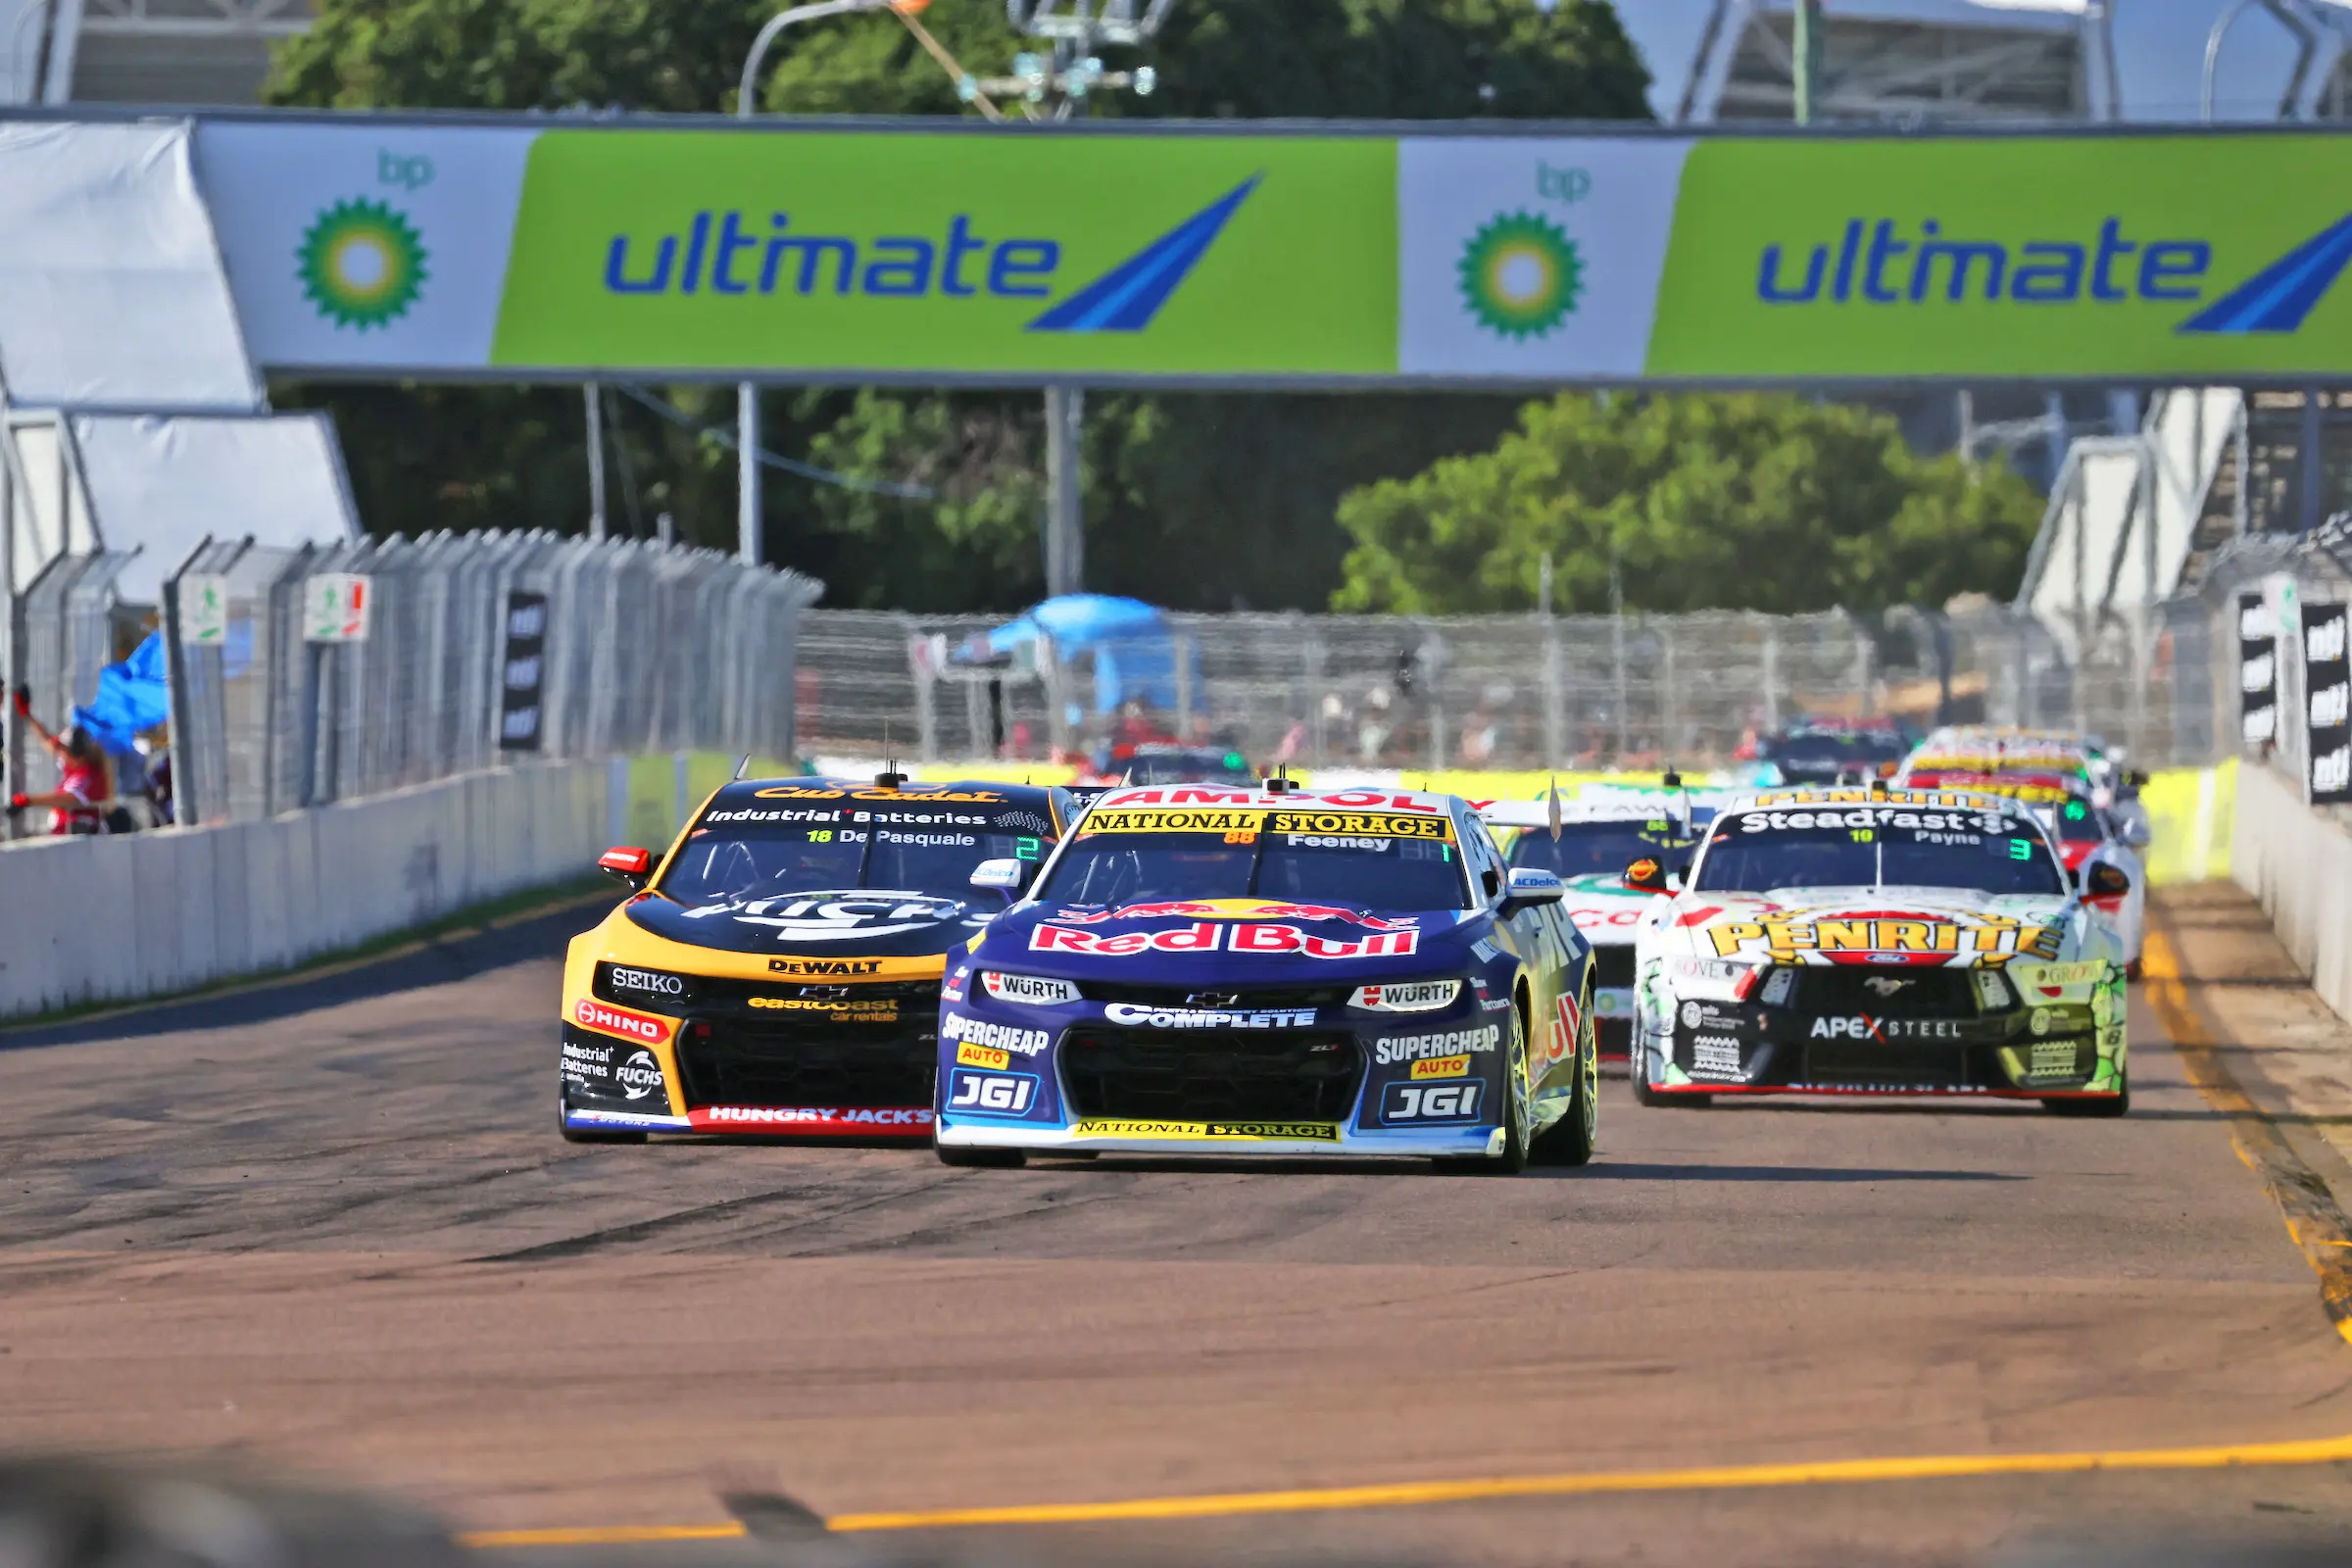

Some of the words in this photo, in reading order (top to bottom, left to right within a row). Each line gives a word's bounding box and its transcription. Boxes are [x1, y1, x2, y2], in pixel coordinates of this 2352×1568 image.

[376, 149, 435, 190] bp
[1537, 161, 1592, 203] bp
[604, 210, 1061, 298] ultimate
[1756, 217, 2213, 305] ultimate
[706, 808, 841, 823] Industrial
[853, 810, 987, 825] Batteries
[1088, 813, 1255, 830] NATIONAL
[1275, 813, 1439, 837] STORAGE
[1740, 808, 1965, 833] Steadfast
[807, 830, 832, 843] 18
[840, 830, 867, 843] De
[875, 830, 976, 847] Pasquale
[1015, 836, 1041, 860] 2
[1224, 833, 1255, 845] 88
[1287, 834, 1392, 853] Feeney
[1915, 830, 1981, 846] Payne
[2009, 838, 2032, 861] 3
[1028, 922, 1224, 956] Red
[1227, 923, 1421, 959] Bull
[1706, 918, 2064, 961] PENRITE
[612, 967, 683, 995] SEIKO
[1004, 977, 1068, 1000] WÜRTH
[748, 997, 899, 1010] eastcoast
[1385, 983, 1453, 1004] WÜRTH
[596, 1010, 659, 1038] HINO
[830, 1012, 852, 1021] car
[854, 1010, 898, 1021] rentals
[1103, 1003, 1317, 1028] COMPLETE
[942, 1011, 1050, 1056] SUPERCHEAP
[1811, 1011, 1886, 1045] APEX
[1888, 1020, 1962, 1038] STEEL
[962, 1048, 1004, 1064] AUTO
[1375, 1024, 1499, 1065] SUPERCHEAP
[561, 1056, 609, 1078] Batteries
[615, 1066, 664, 1087] FUCHS
[1417, 1059, 1464, 1074] AUTO
[952, 1076, 1031, 1110] JGI
[1389, 1086, 1478, 1119] JGI
[710, 1106, 836, 1122] HUNGRY
[841, 1108, 932, 1124] JACK'S
[1078, 1121, 1201, 1134] NATIONAL
[1212, 1124, 1332, 1138] STORAGE
